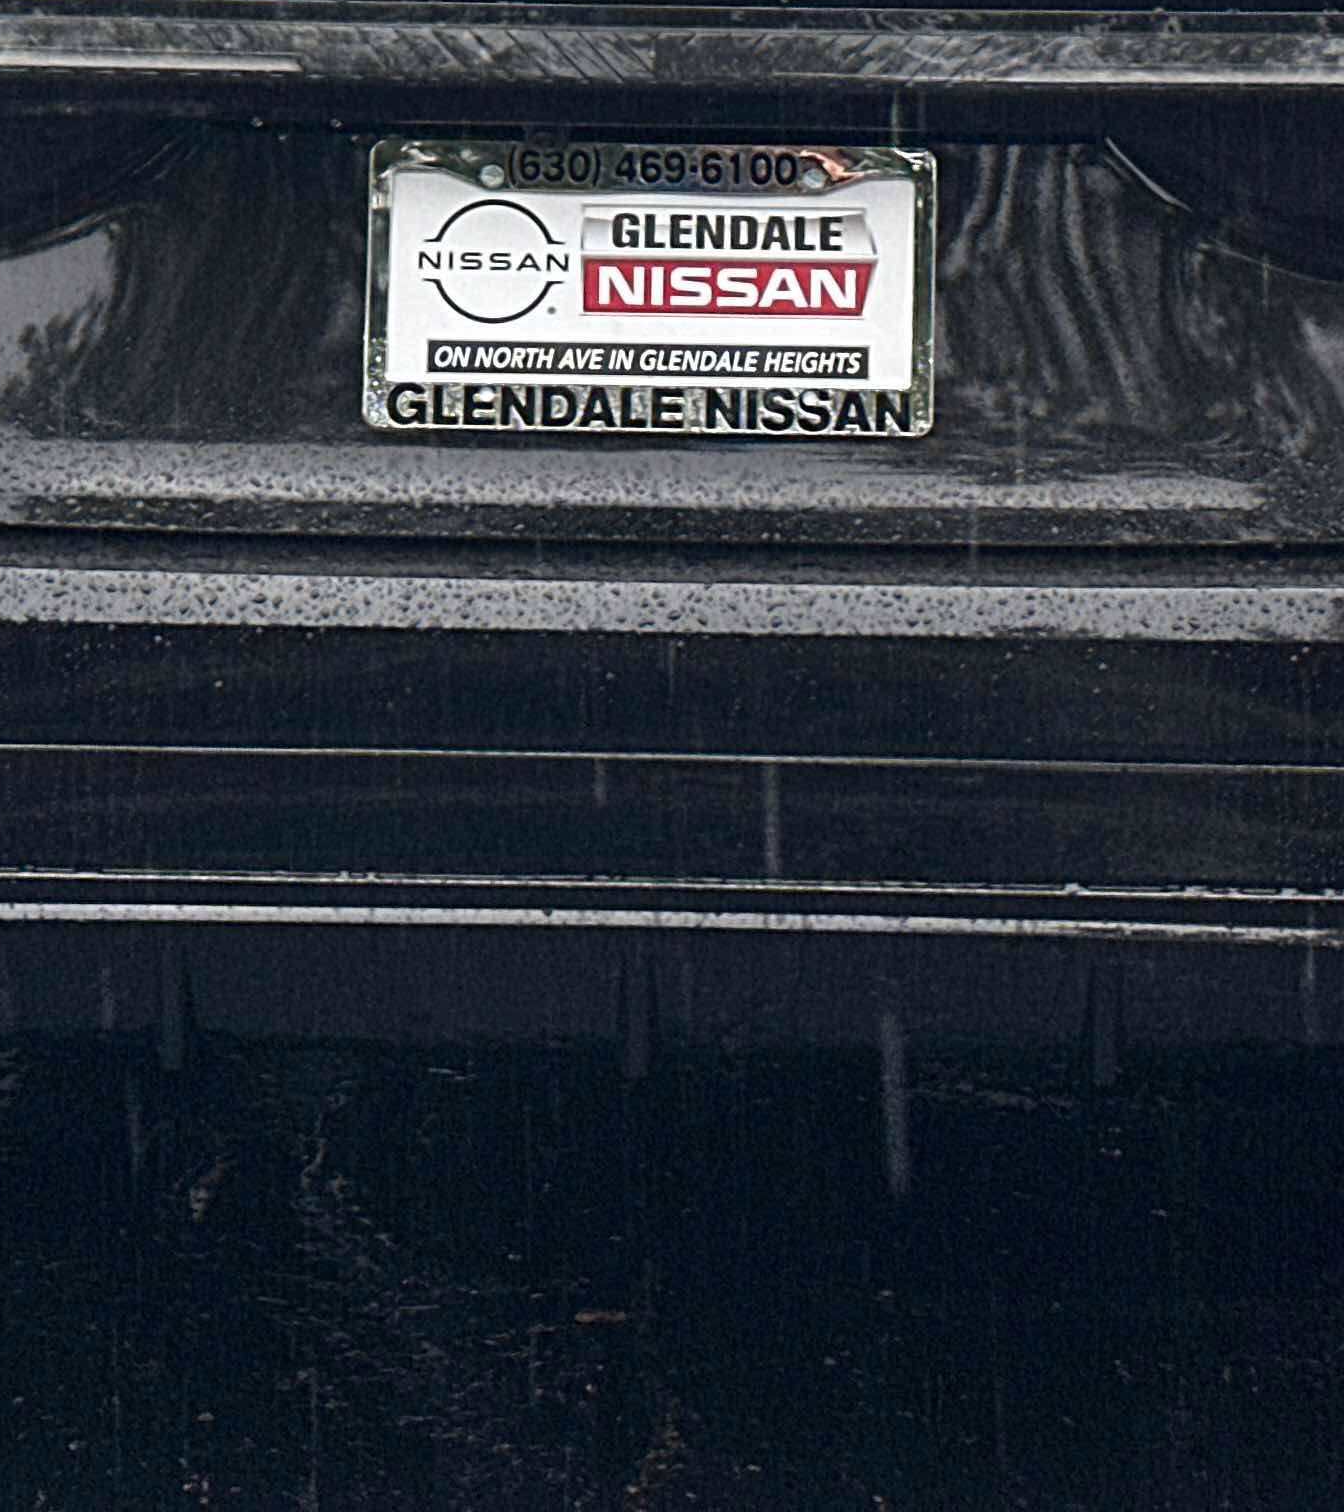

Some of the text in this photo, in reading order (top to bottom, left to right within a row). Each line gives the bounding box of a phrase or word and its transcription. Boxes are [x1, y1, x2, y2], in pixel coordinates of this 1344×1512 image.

[508, 144, 601, 187] (630)
[611, 212, 844, 252] GLENDALE
[418, 251, 570, 272] NISSAN
[597, 265, 857, 310] NISSAN
[433, 345, 863, 375] ON NORTH AVE IN GLENDALE HEIGHTS
[386, 382, 912, 433] GLENDALE NISSAN
